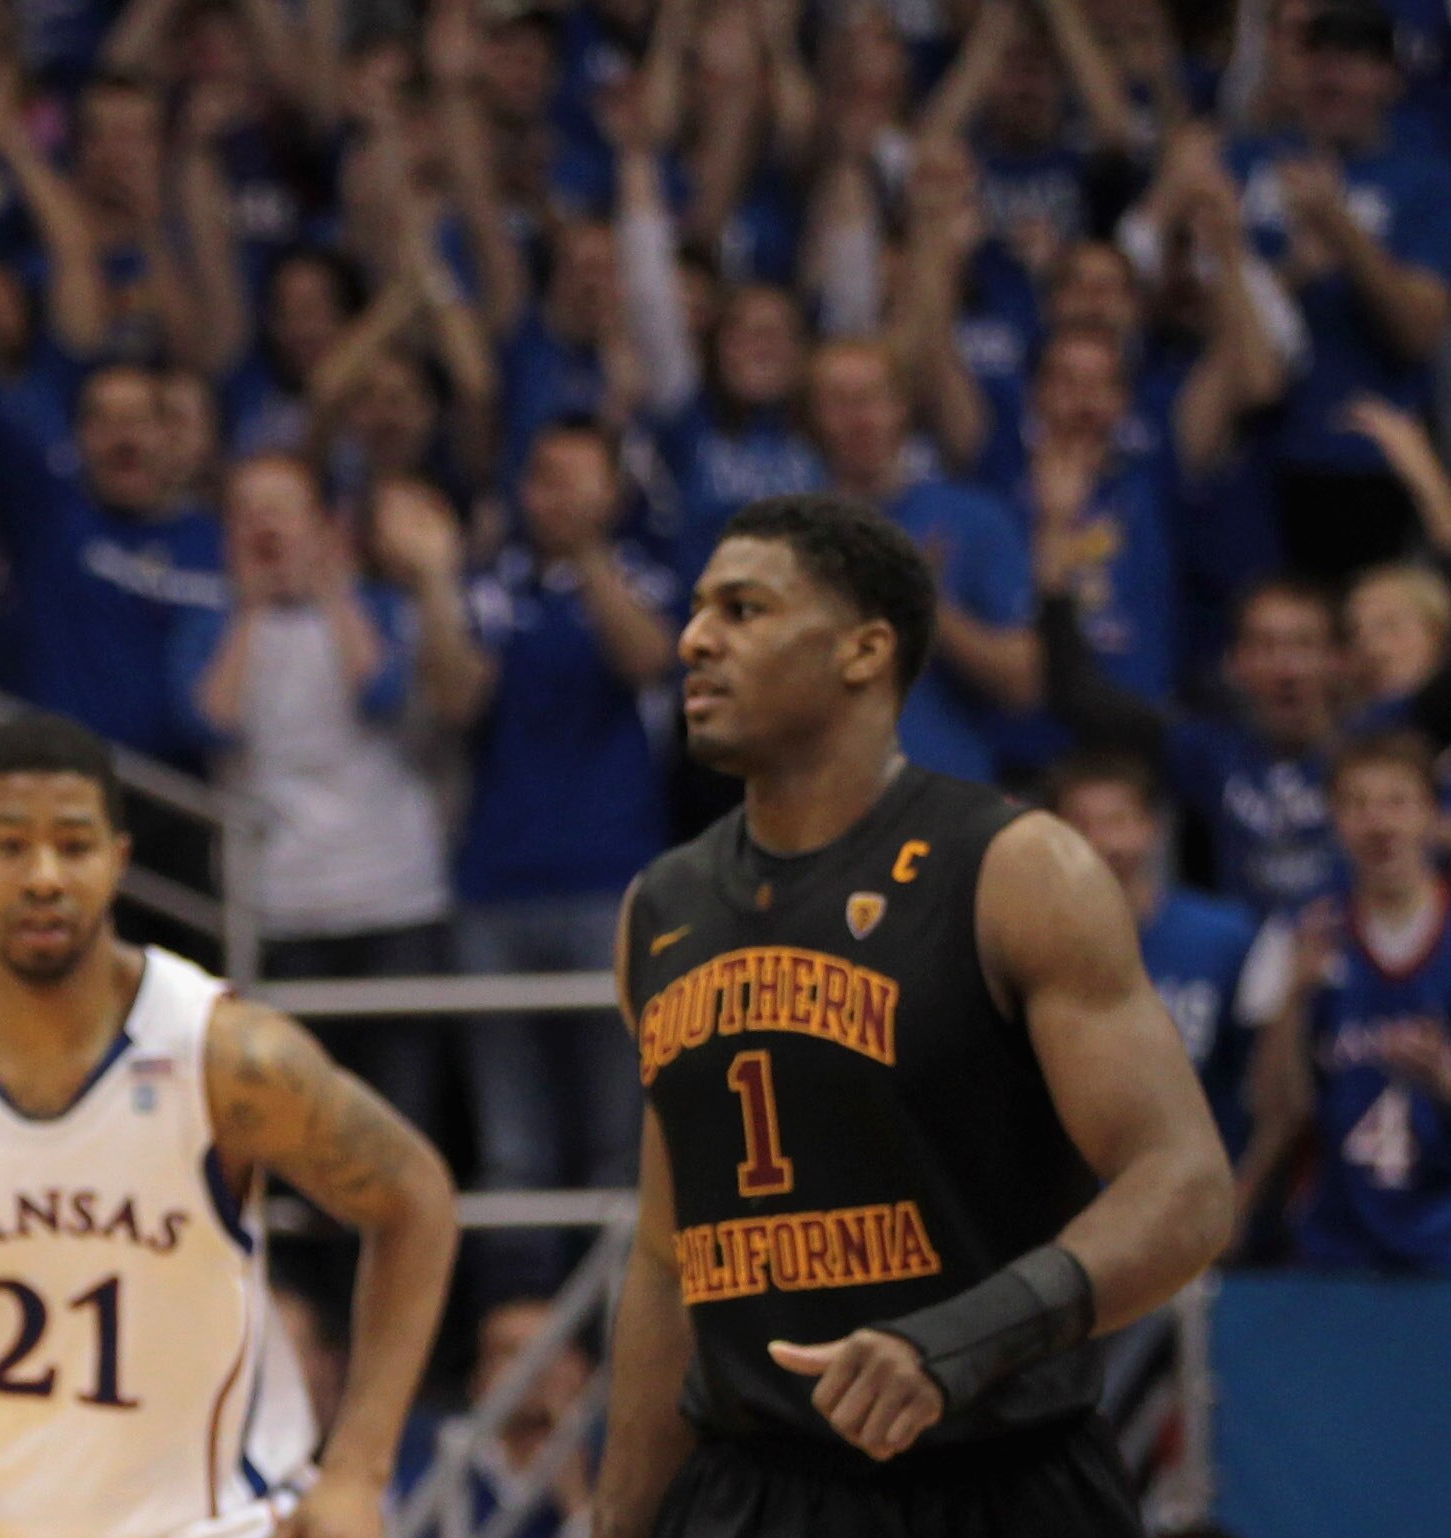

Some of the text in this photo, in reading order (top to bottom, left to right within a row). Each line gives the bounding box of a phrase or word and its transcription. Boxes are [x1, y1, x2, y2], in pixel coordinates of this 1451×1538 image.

[891, 838, 931, 884] C
[639, 944, 900, 1088] SOUTHERN
[727, 1049, 795, 1198] 1
